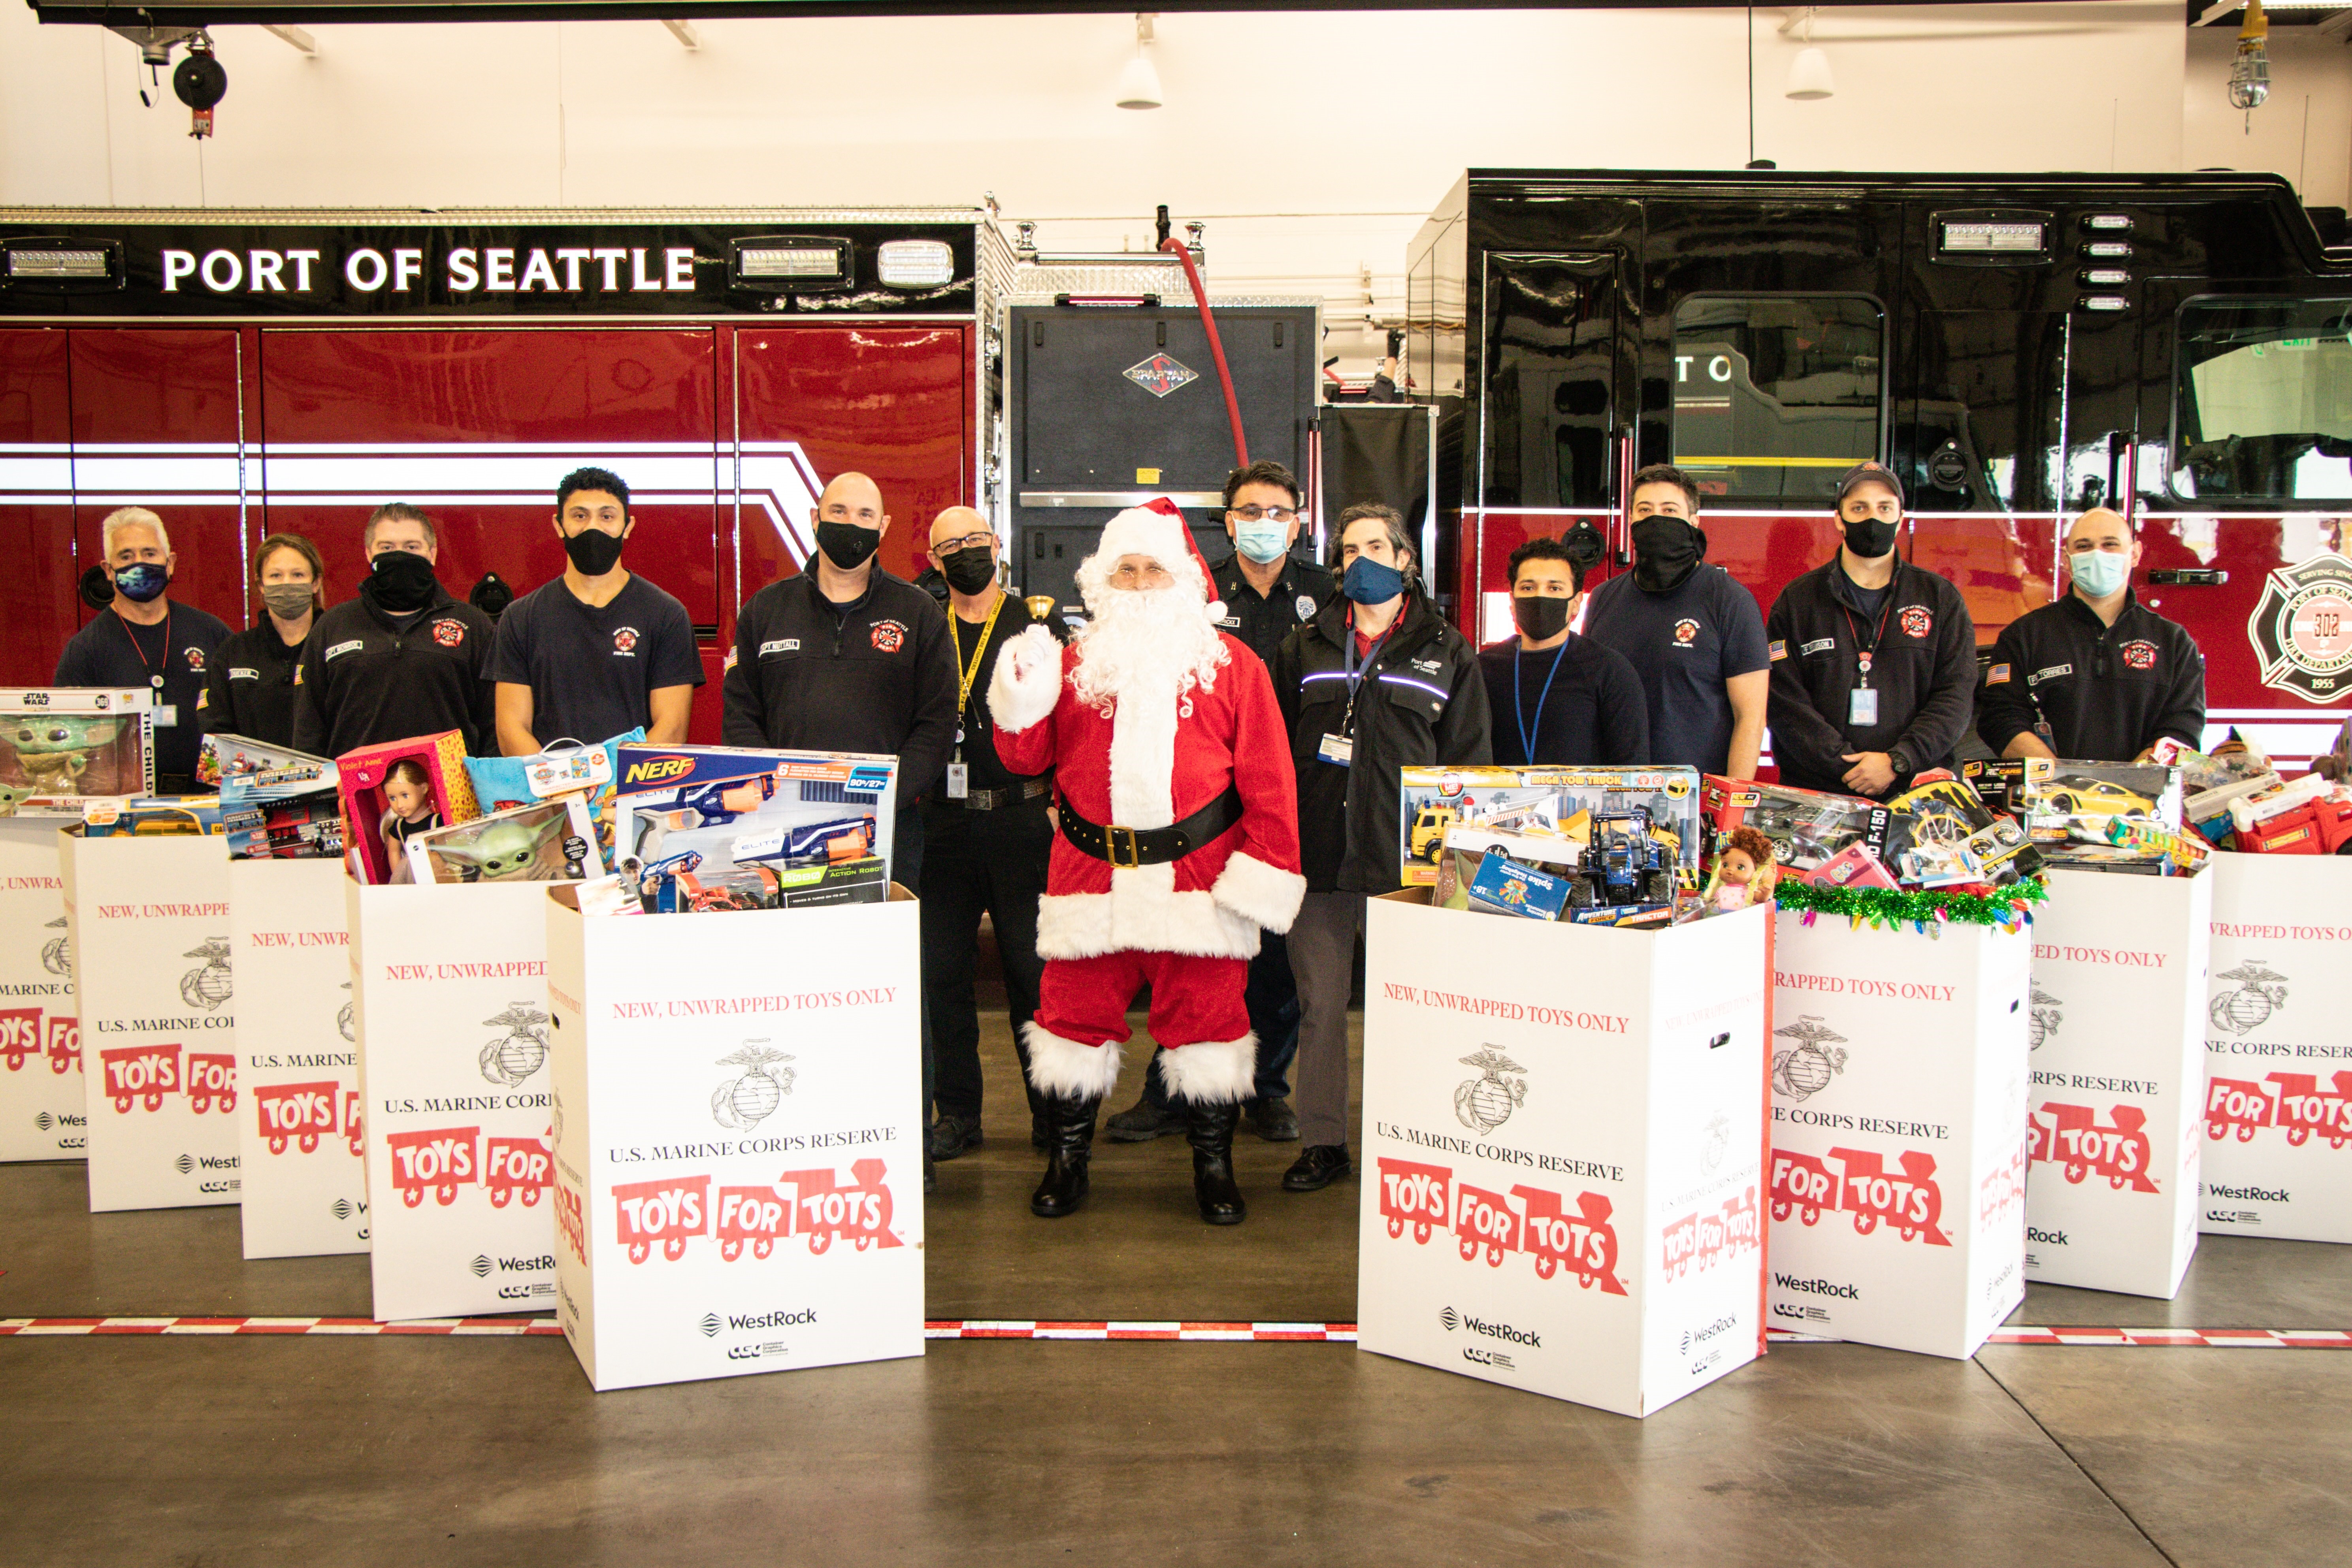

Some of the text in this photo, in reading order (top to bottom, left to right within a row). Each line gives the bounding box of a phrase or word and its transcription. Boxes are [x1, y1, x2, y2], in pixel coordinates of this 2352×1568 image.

[161, 248, 696, 293] PORT OF SEATTLE
[1131, 369, 1190, 381] SPARTAN
[2297, 569, 2333, 581] SERVING
[991, 594, 1002, 615] FIGHTERS
[2289, 587, 2328, 612] PORT OF
[889, 619, 909, 632] SEATTLE
[2313, 613, 2339, 637] 302
[772, 641, 796, 650] NUTTALL
[2284, 638, 2301, 661] FIRE
[971, 648, 982, 671] FIGHTERS
[1419, 665, 1438, 676] Seattle
[2038, 667, 2066, 677] TORRES
[2311, 678, 2335, 688] 1955
[96, 697, 109, 707] 369
[143, 712, 152, 740] THE
[143, 746, 154, 791] CHILD
[261, 765, 320, 778] MIGHTY
[340, 758, 382, 771] Violet Anna
[625, 757, 694, 784] NERF
[778, 764, 790, 776] 6
[258, 771, 320, 786] FLEET
[1530, 775, 1623, 786] MEGA TOW TRUCK
[635, 789, 675, 798] ELITE
[226, 811, 263, 822] MIGHTY
[2029, 828, 2068, 839] CARS
[742, 838, 781, 850] ELITE
[859, 866, 884, 874] ROBOT
[1501, 864, 1527, 878] Hedgehog
[1472, 885, 1487, 895] 18+
[1528, 875, 1553, 890] Spike
[99, 905, 139, 920] NEW,
[1576, 908, 1617, 922] ADVENTURE
[1631, 910, 1668, 922] TRACTOR
[252, 932, 294, 948] NEW,
[2290, 926, 2335, 940] TOYS
[2063, 947, 2111, 964] TOYS
[2115, 951, 2167, 968] ONLY
[386, 965, 433, 982] NEW,
[1848, 979, 1956, 1001] TOYS ONLY
[612, 987, 897, 1020] NEW, UNWRAPPED TOYS ONLY
[1384, 982, 1630, 1034] NEW, UNWRAPPED TOYS ONLY
[98, 1020, 128, 1033] U.S.
[132, 1017, 200, 1031] MARINE
[2231, 1041, 2291, 1056] CORPS
[251, 1052, 357, 1068] U.S. MARINE
[108, 1052, 176, 1089] TOYS
[2071, 1075, 2159, 1095] RESERVE
[262, 1091, 332, 1129] TOYS
[384, 1097, 501, 1114] U.S. MARINE
[2209, 1085, 2352, 1133] FOR TOTS
[1790, 1109, 1854, 1129] CORPS
[1858, 1117, 1949, 1139] RESERVE
[609, 1127, 897, 1163] U.S. MARINE CORPS RESERVE
[1376, 1122, 1624, 1182] U.S. MARINE CORPS RESERVE
[2060, 1128, 2139, 1172] TOTS
[396, 1138, 548, 1182] TOYS FOR
[1772, 1158, 1830, 1203] FOR
[1848, 1176, 1929, 1223] TOTS
[2209, 1184, 2290, 1202] WestRock
[621, 1188, 702, 1234] TOYS
[721, 1194, 782, 1233] FOR
[802, 1191, 881, 1230] TOTS
[1383, 1173, 1445, 1217] TOYS
[1460, 1193, 1512, 1243] FOR
[1530, 1216, 1606, 1269] TOTS
[1664, 1209, 1754, 1261] TOYS FOR TOTS
[1775, 1272, 1859, 1300] WestRock
[728, 1308, 817, 1331] WestRock
[1694, 1312, 1737, 1344] WestRock
[1464, 1314, 1541, 1348] WestRock
